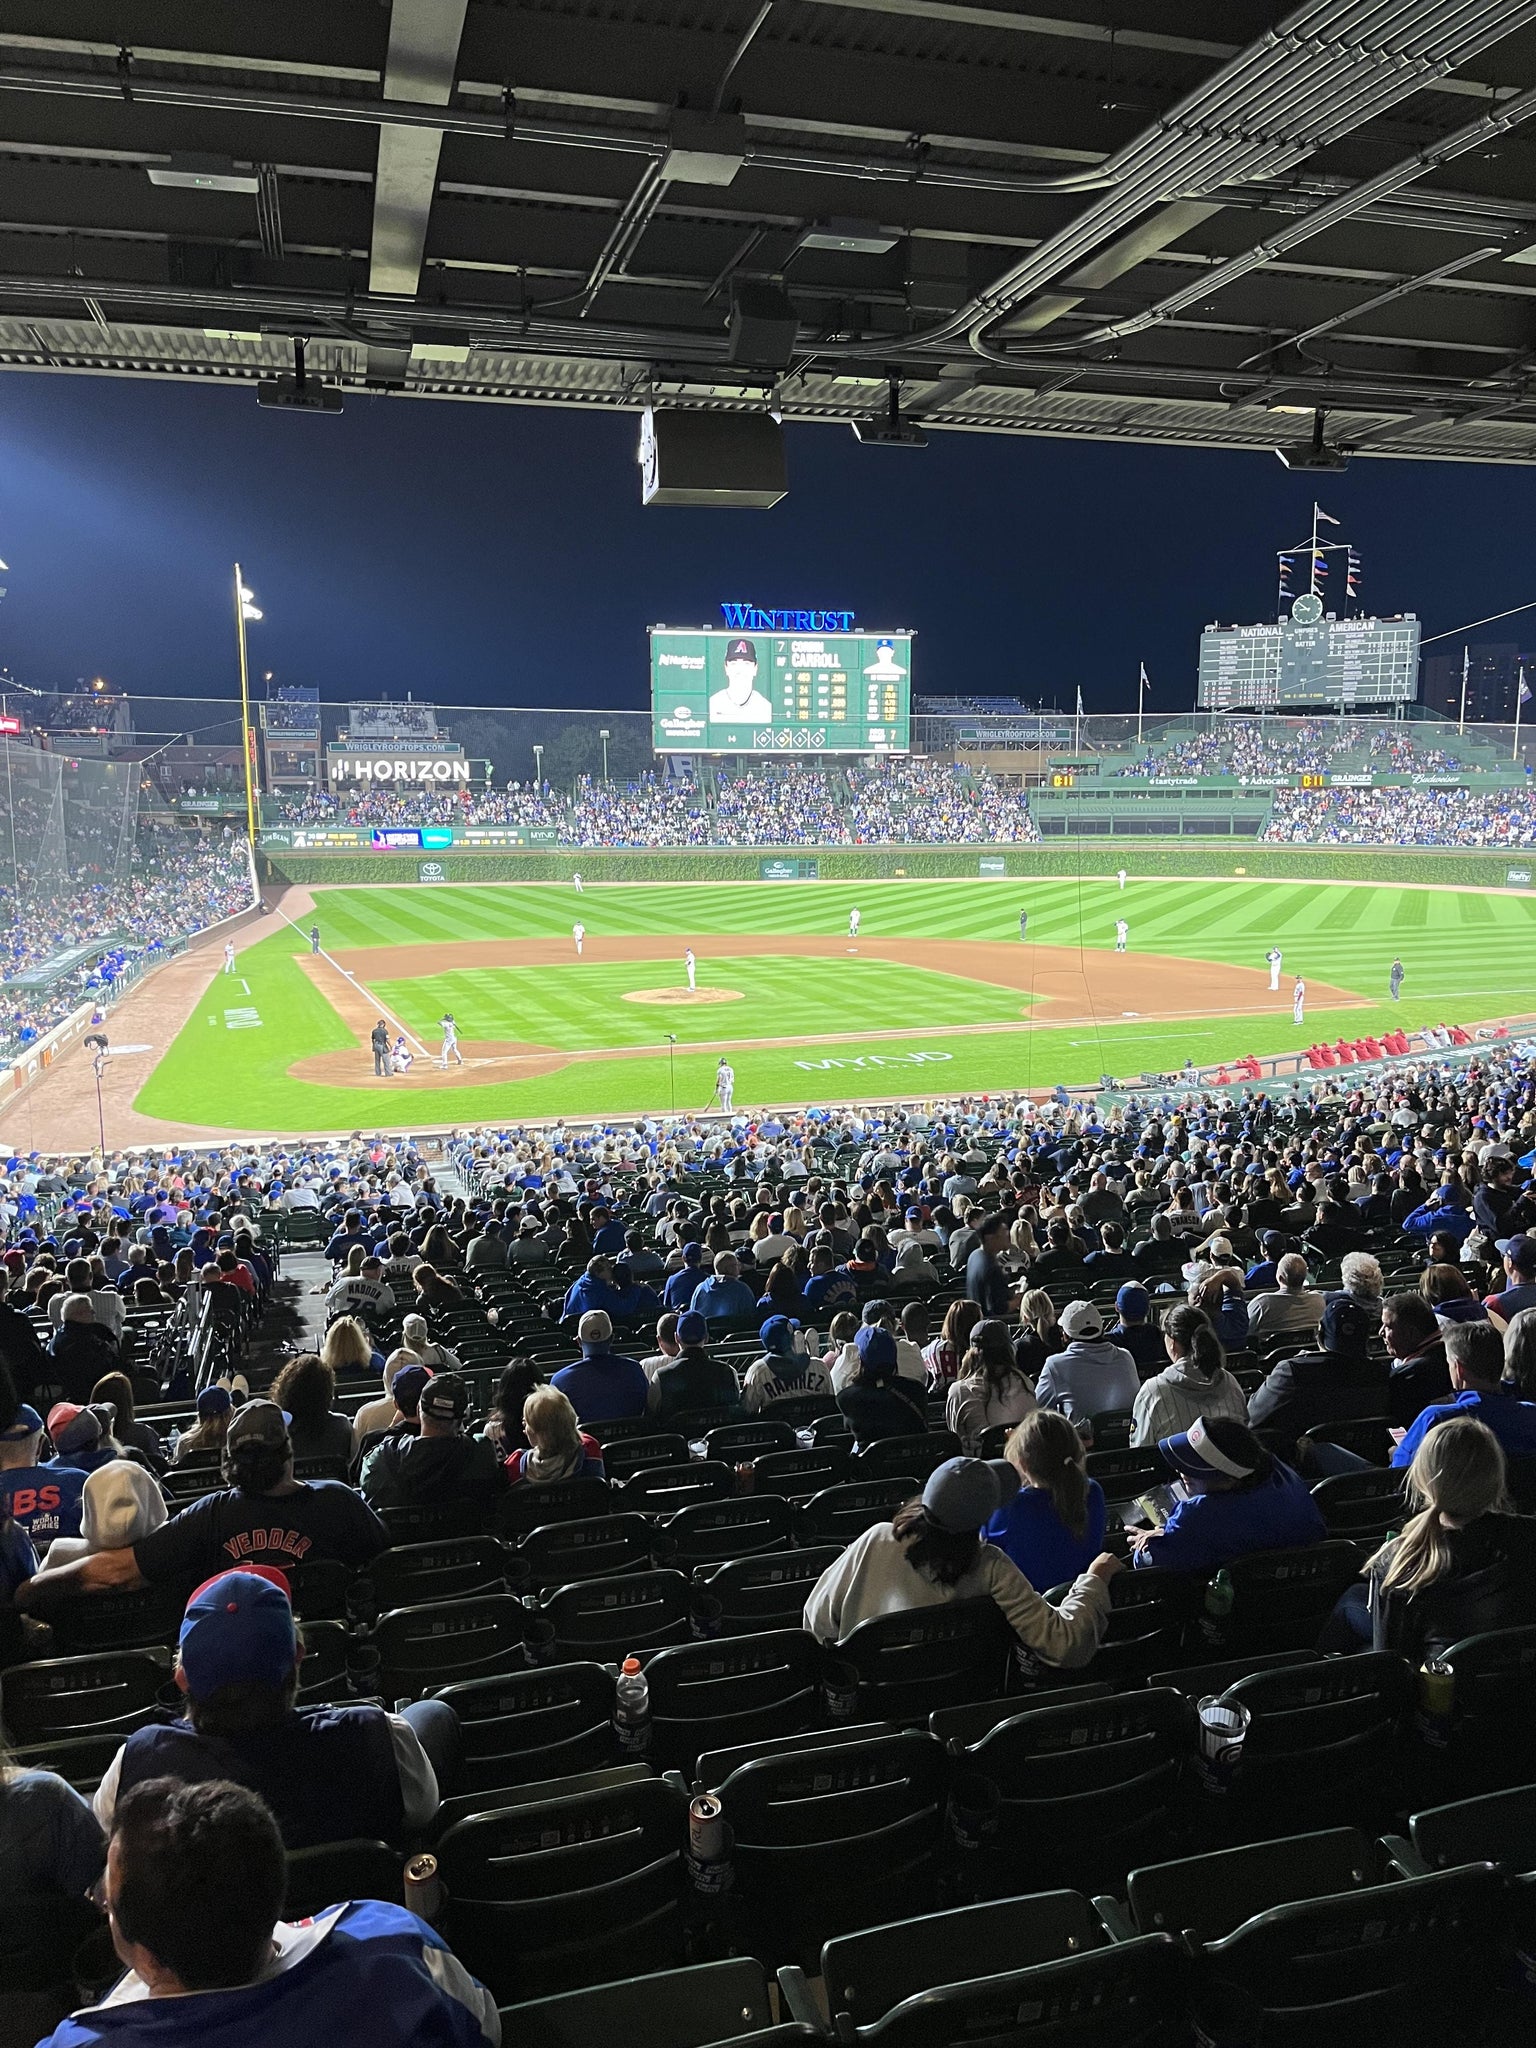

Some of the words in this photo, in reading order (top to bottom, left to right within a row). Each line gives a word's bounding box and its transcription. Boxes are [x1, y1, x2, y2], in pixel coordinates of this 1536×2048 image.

[721, 603, 855, 632] WINTRUST
[1240, 628, 1284, 637] NATIONAL
[1329, 622, 1375, 632] AMERICAN
[777, 641, 785, 652] 7
[792, 653, 841, 668] CARROLL
[976, 730, 1056, 738] WRIGLEYROOFTOPS.COM
[345, 743, 446, 751] WRIGLEYROOFTOPS.COM
[355, 760, 470, 780] HORIZON
[1156, 778, 1198, 786] tastytrade
[1412, 773, 1460, 784] Budweiser
[272, 832, 289, 844] BEAM
[1508, 871, 1531, 882] Hefty
[793, 1052, 953, 1070] MYND
[348, 1284, 383, 1300] MADDON
[13, 1485, 61, 1516] BS
[32, 1516, 60, 1524] WORLD
[32, 1522, 60, 1532] SERIES
[222, 1528, 312, 1560] VEDDER
